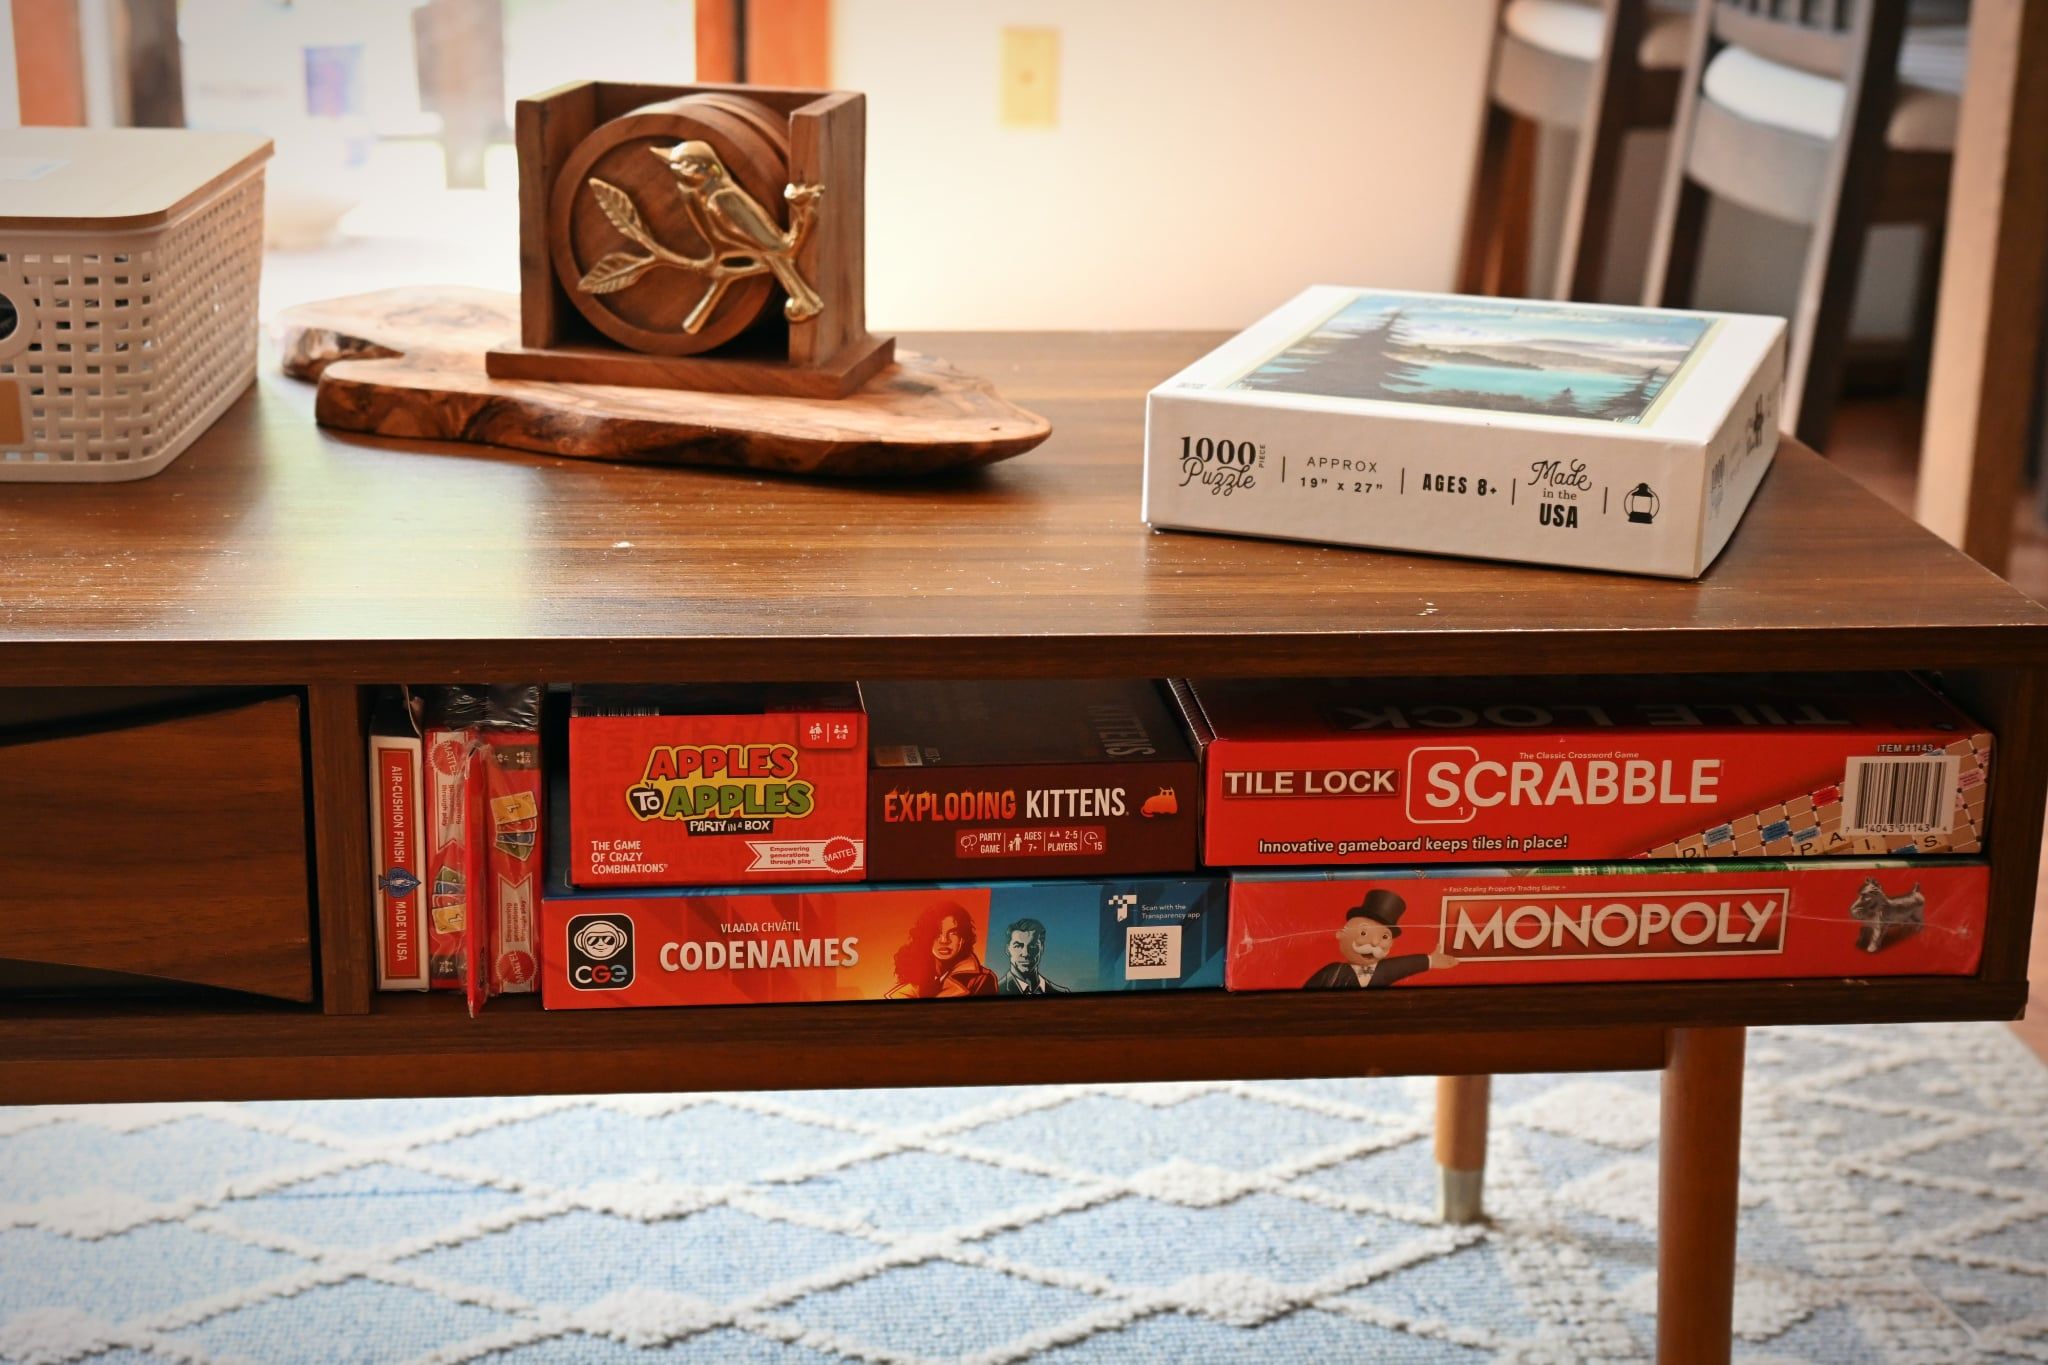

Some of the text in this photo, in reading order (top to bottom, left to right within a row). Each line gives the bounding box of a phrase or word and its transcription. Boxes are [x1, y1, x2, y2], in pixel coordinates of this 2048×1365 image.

[1179, 436, 1257, 466] 1000
[1258, 443, 1267, 468] PIECE
[1306, 456, 1378, 473] APPROX
[1178, 456, 1257, 497] Puzzle
[1527, 458, 1593, 492] Made
[1337, 482, 1345, 491] x
[1422, 473, 1497, 496] AGES 8+
[1543, 488, 1577, 501] in the
[1539, 502, 1579, 529] USA
[1876, 743, 1935, 753] ITEM #1143
[443, 740, 457, 776] MATTEL
[1519, 751, 1640, 760] The Classic Crossword Game
[646, 746, 796, 780] APPLES
[1224, 769, 1396, 795] TILE LOCK
[1425, 759, 1721, 808] SCRABBLE
[391, 765, 404, 828] AIR-CUSHION
[664, 782, 812, 817] APPLES
[884, 787, 1017, 823] EXPLODING
[1457, 806, 1464, 816] 1
[690, 820, 727, 833] PARTY
[727, 823, 737, 832] IN
[744, 820, 771, 831] BOX
[1865, 824, 1894, 833] 14043
[1899, 824, 1930, 833] 01143
[979, 832, 1002, 842] PARTY
[1024, 831, 1042, 841] AGES
[1065, 830, 1078, 840] 2-5
[393, 830, 405, 863] FINISH
[591, 839, 641, 851] THE GAME
[769, 846, 810, 854] Empowering
[980, 844, 1001, 854] GAME
[1028, 843, 1038, 852] 7+
[1047, 842, 1078, 852] PLAYERS
[1094, 842, 1103, 851] 15
[1258, 835, 1568, 856] Innovative gameboard keeps tiles in place!
[591, 851, 643, 863] OF CRAZY
[769, 852, 810, 860] generations
[823, 847, 858, 863] MATTEL
[769, 858, 796, 866] through
[1448, 886, 1487, 894] Fast-Dealing
[1488, 885, 1517, 893] Property
[1517, 884, 1541, 892] Trading
[1159, 903, 1173, 911] with
[1141, 911, 1186, 920] Transparency
[395, 901, 408, 962] MADE IN USA
[720, 919, 801, 933] VLAADA CHVÁTIL
[1452, 901, 1778, 951] MONOPOLY
[659, 937, 860, 973] CODENAMES
